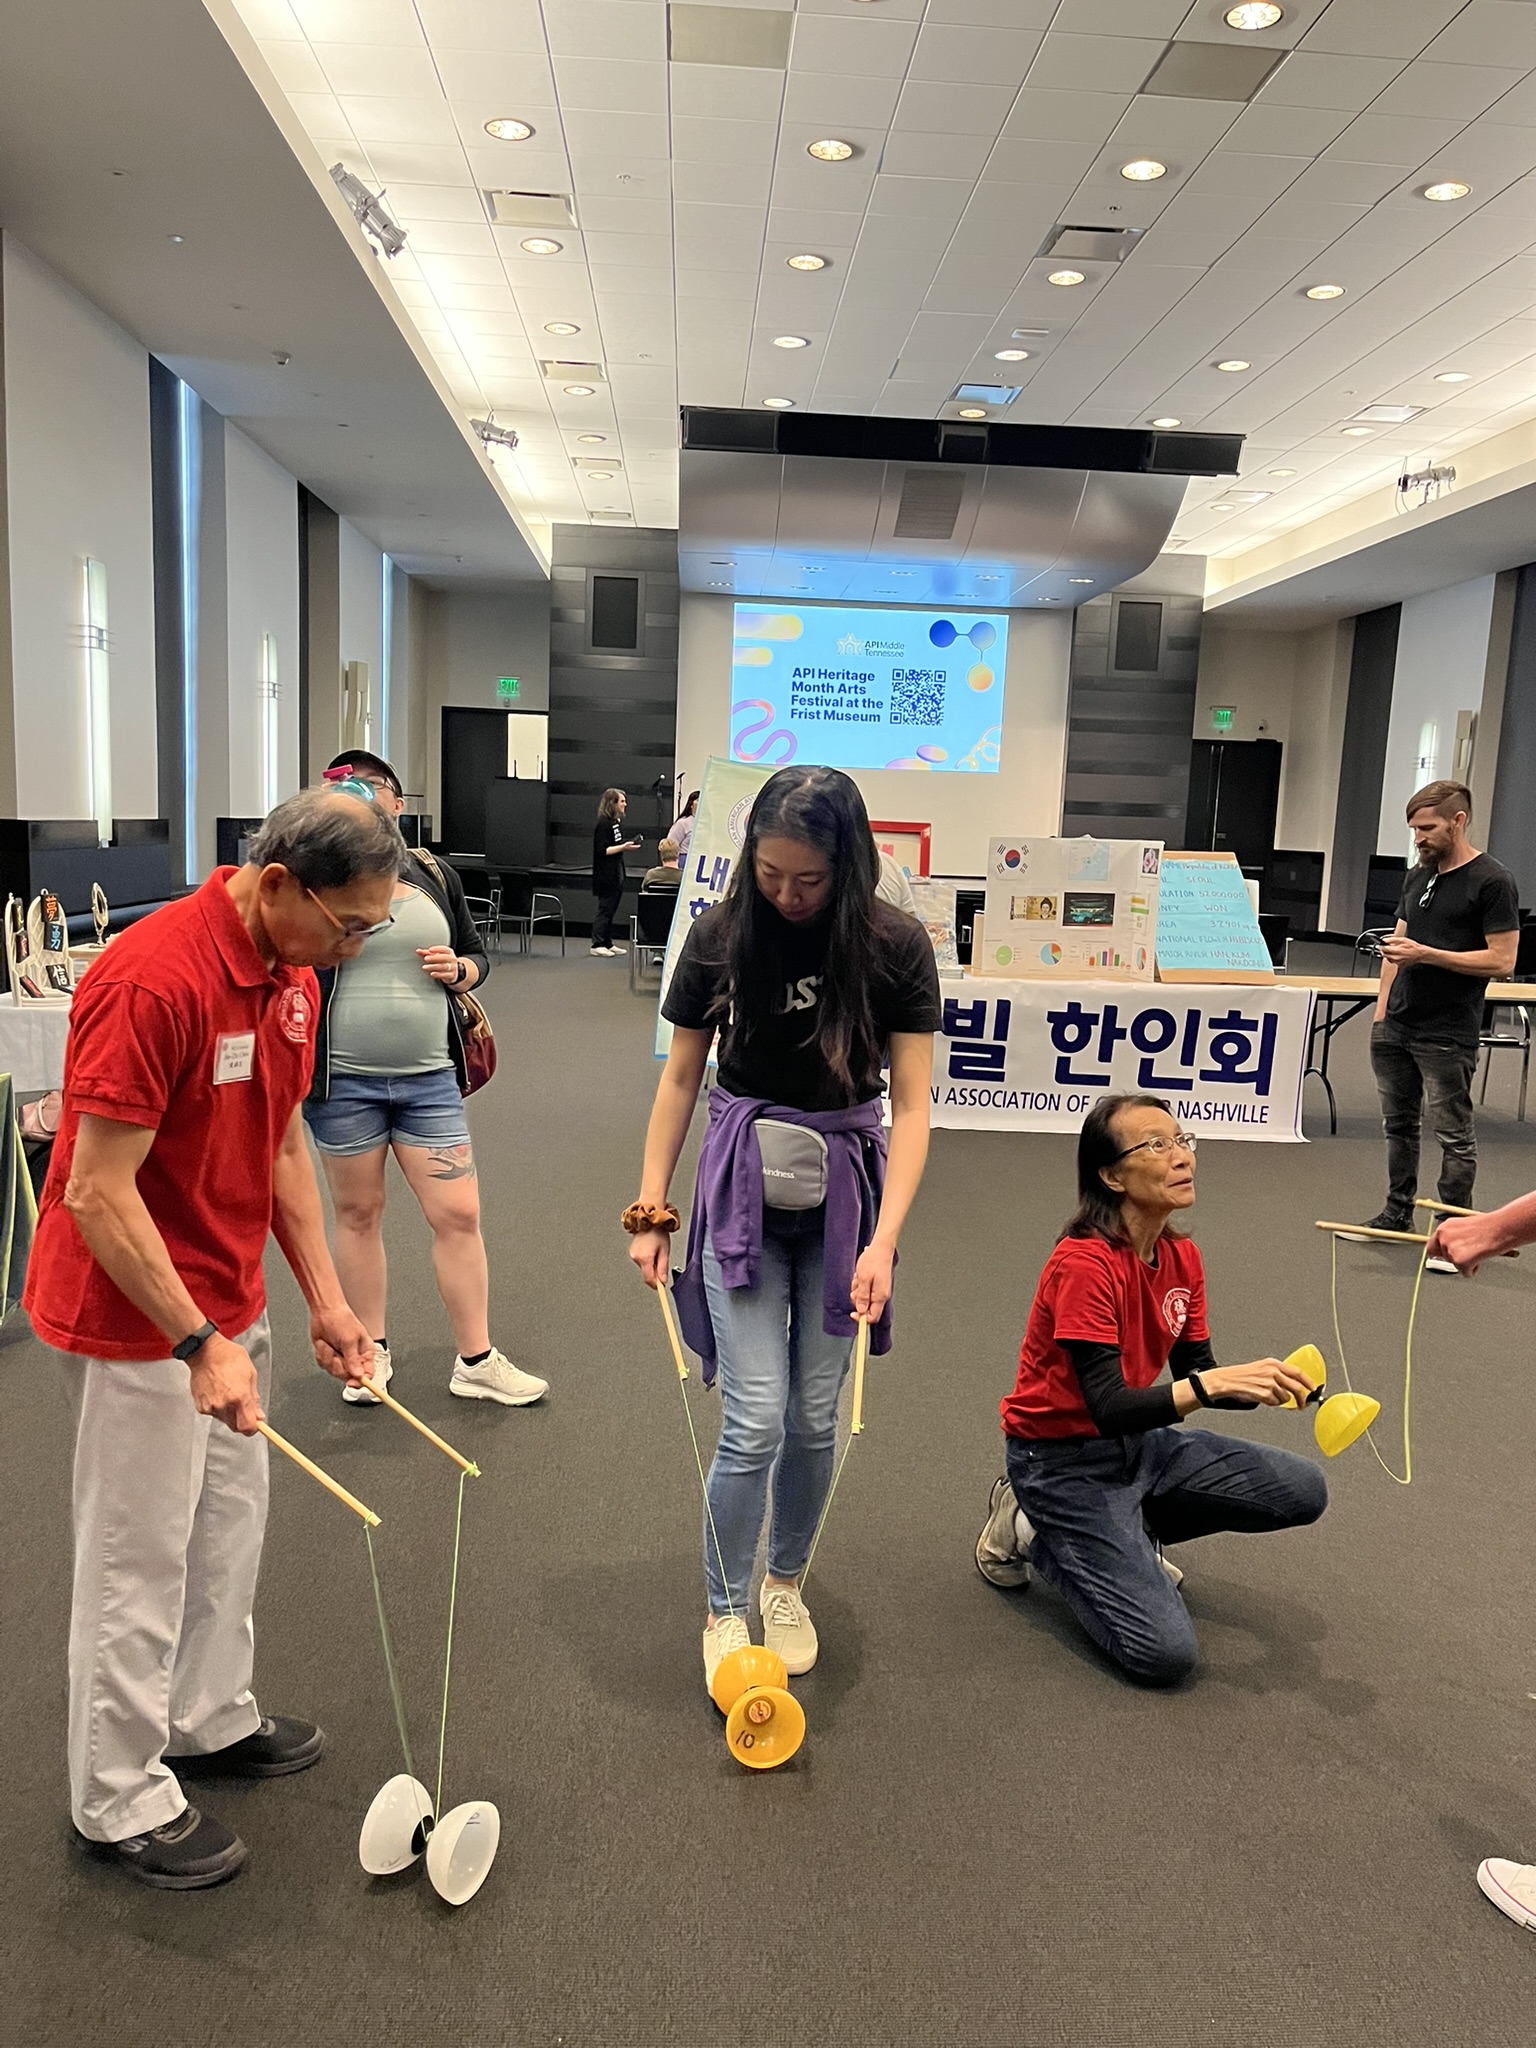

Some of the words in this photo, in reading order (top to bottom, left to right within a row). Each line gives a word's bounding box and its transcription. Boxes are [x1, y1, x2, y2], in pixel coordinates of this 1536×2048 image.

[880, 641, 905, 650] Middle
[865, 649, 904, 658] Tennessee
[792, 667, 815, 679] API
[818, 668, 875, 684] Heritage
[791, 681, 834, 693] Month
[837, 683, 867, 695] Arts
[791, 694, 843, 707] Festival
[846, 698, 859, 708] at
[862, 698, 884, 709] the
[790, 708, 821, 720] Frist
[823, 709, 881, 722] Museum
[1186, 876, 1216, 884] SEOUL
[1159, 904, 1180, 912] NEY
[1203, 904, 1228, 912] WON
[52, 965, 67, 986] 信
[1046, 1001, 1279, 1097] 한인회
[944, 1086, 1061, 1112] ASSOCIATION
[1066, 1094, 1091, 1113] OF
[1177, 1100, 1270, 1124] NASHVILLE
